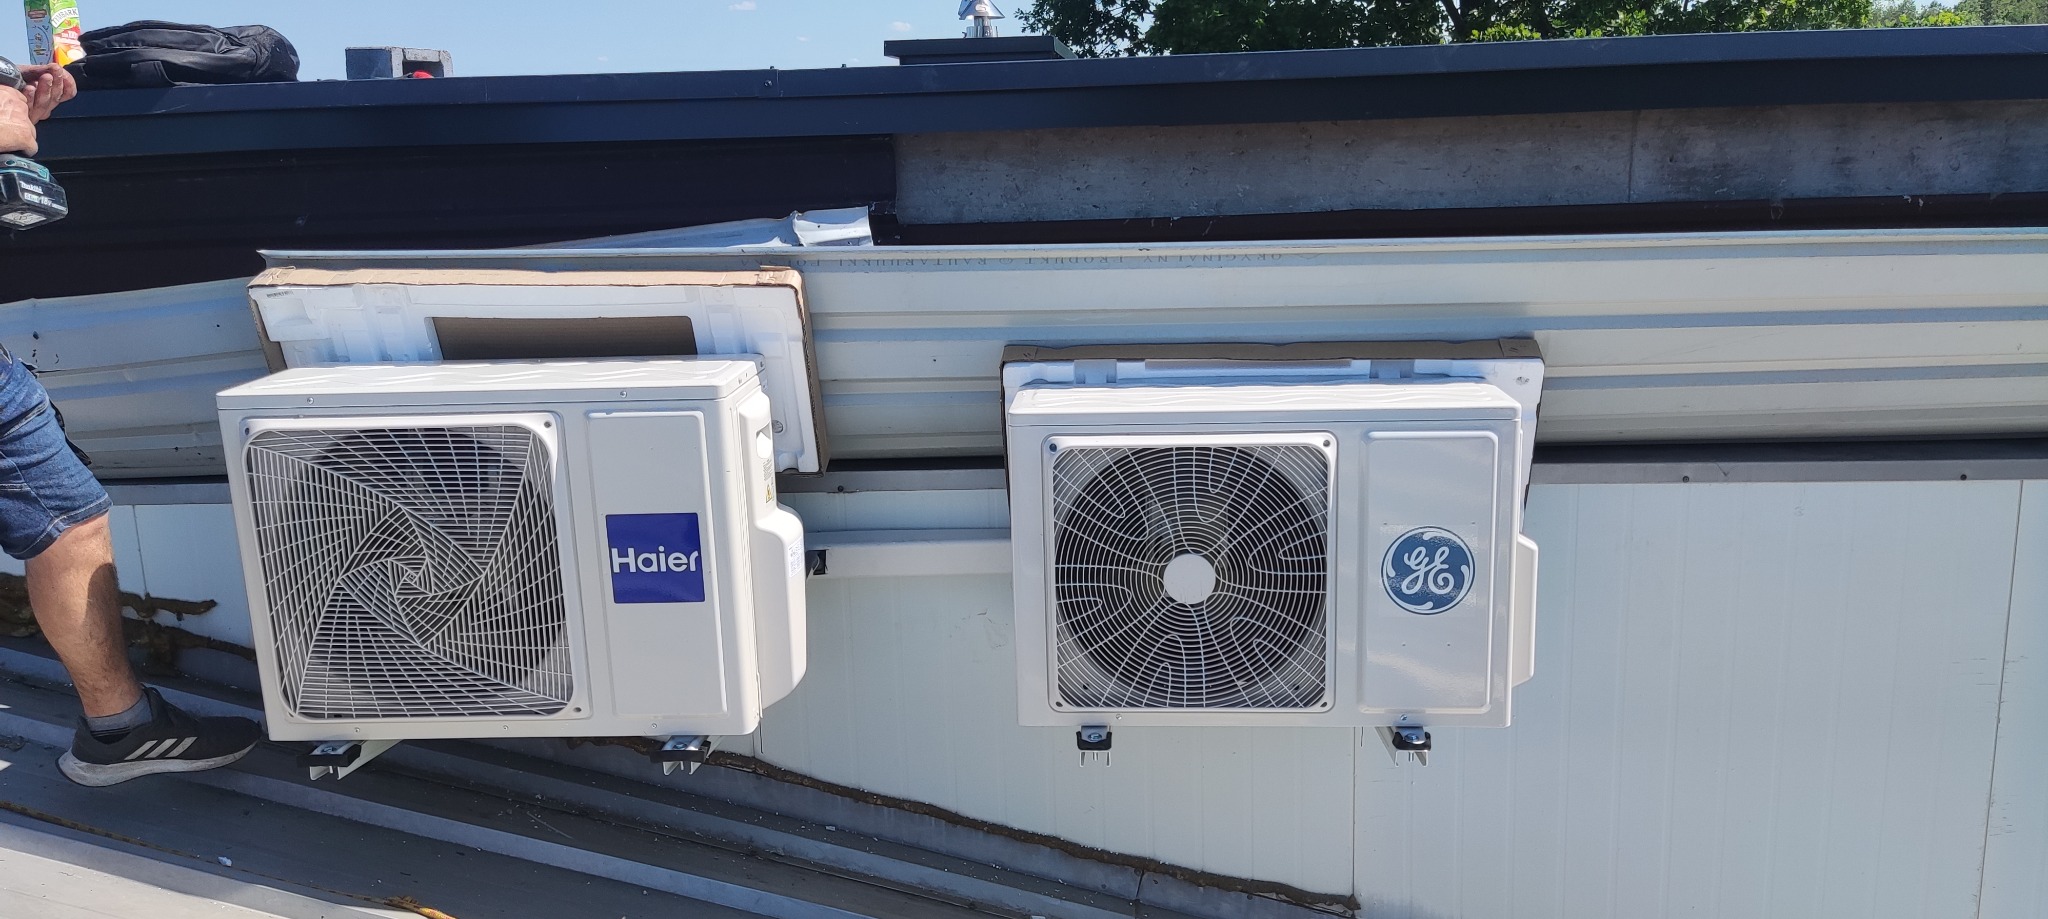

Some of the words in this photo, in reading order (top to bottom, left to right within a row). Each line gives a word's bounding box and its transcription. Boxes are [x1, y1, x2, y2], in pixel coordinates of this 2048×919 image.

[52, 8, 79, 26] TYMBARK
[611, 545, 699, 573] Haier
[1401, 546, 1455, 595] GE
